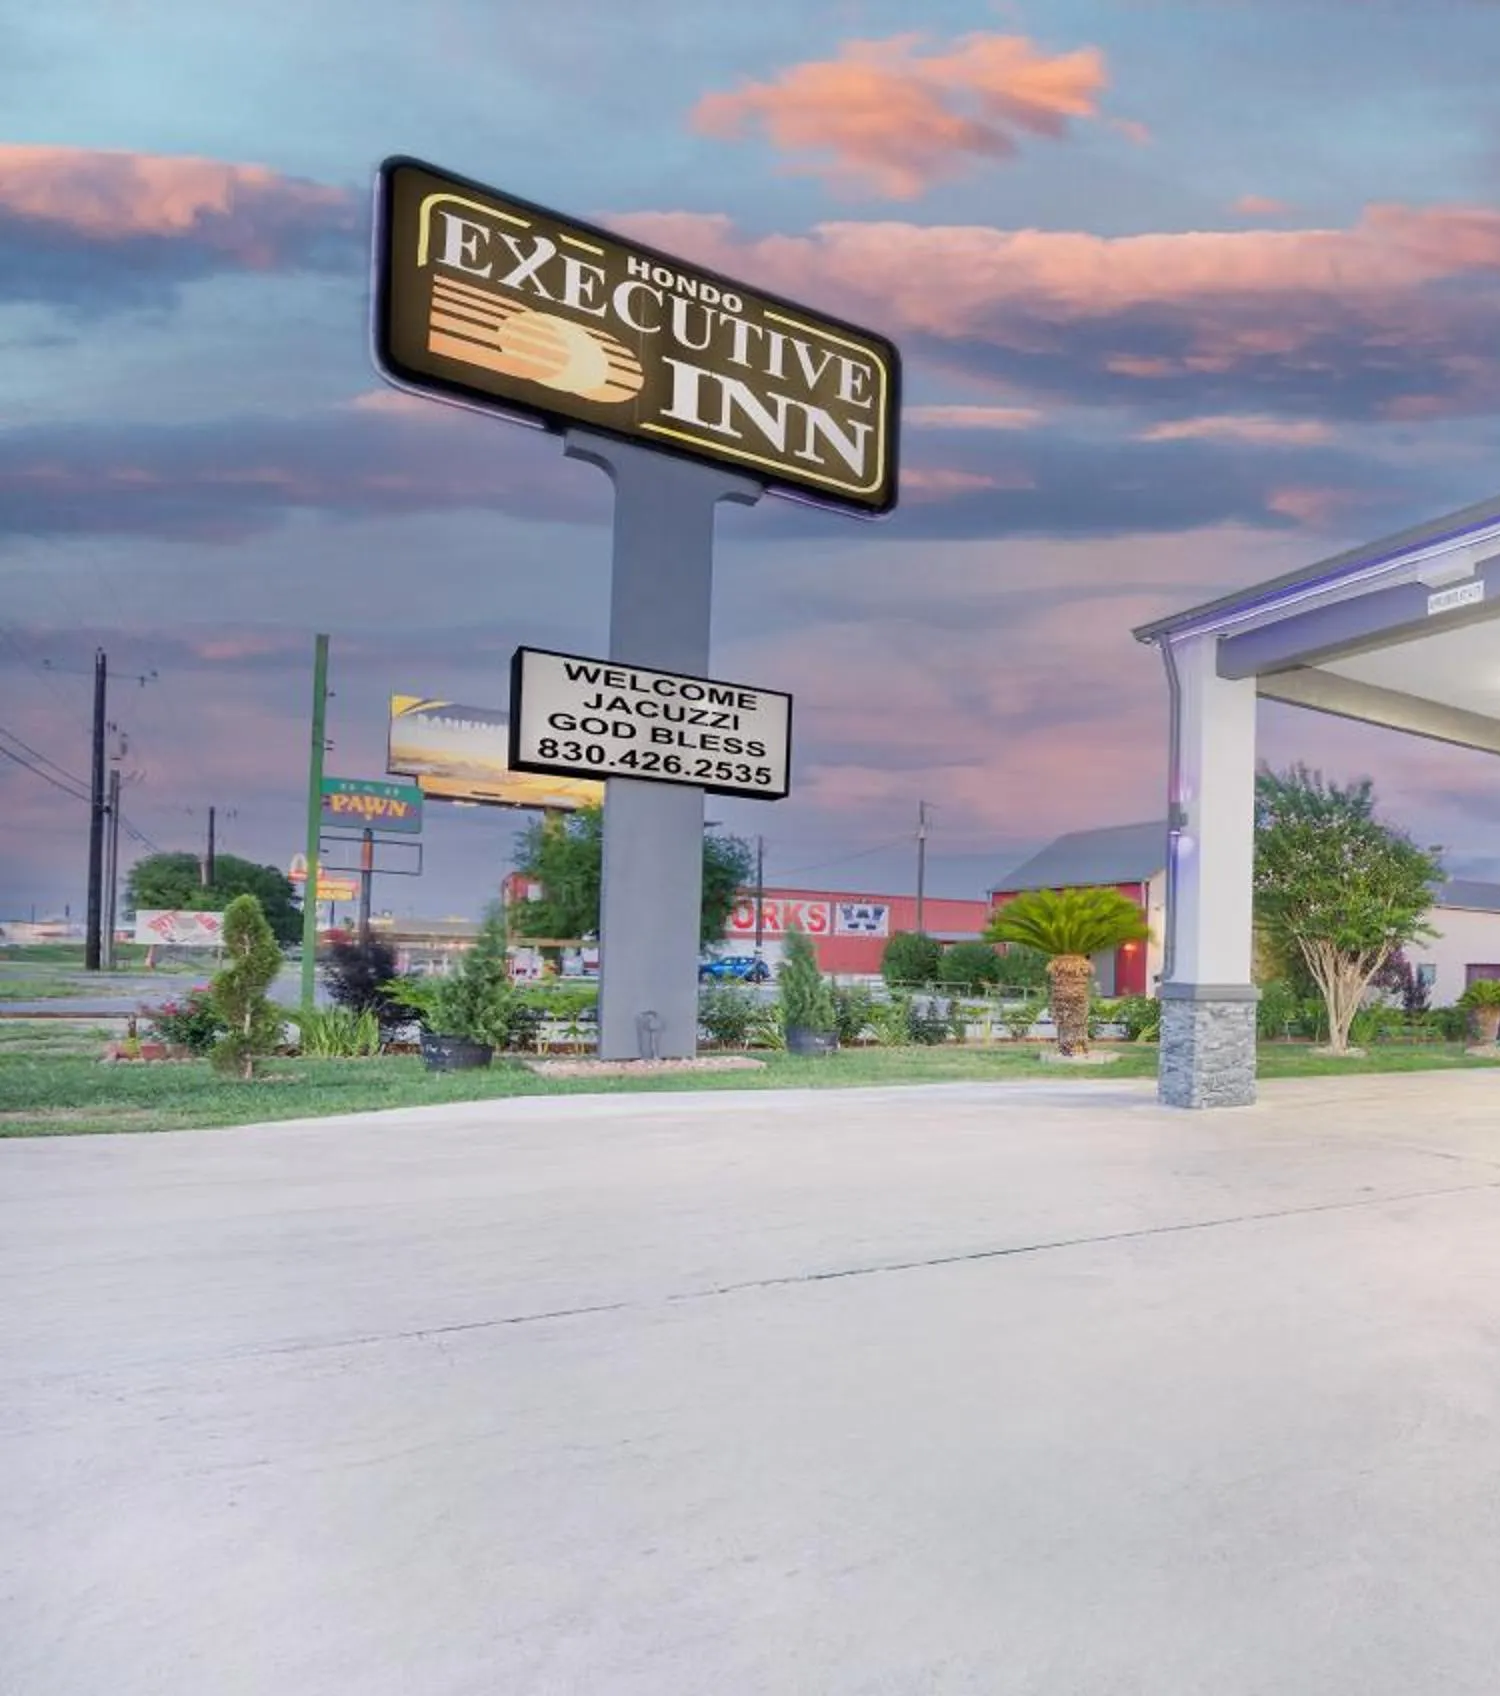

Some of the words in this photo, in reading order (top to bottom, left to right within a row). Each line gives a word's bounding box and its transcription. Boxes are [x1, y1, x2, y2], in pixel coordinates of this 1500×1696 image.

[627, 256, 743, 313] HONDO
[437, 211, 873, 409] EXECUTIVE
[661, 357, 873, 478] INN
[563, 662, 758, 711] WELCOME
[547, 713, 637, 739] GOD
[650, 726, 767, 758] BLESS
[583, 693, 740, 731] JACUZZI
[537, 738, 772, 785] 830.426.2535
[331, 794, 409, 819] PAWN
